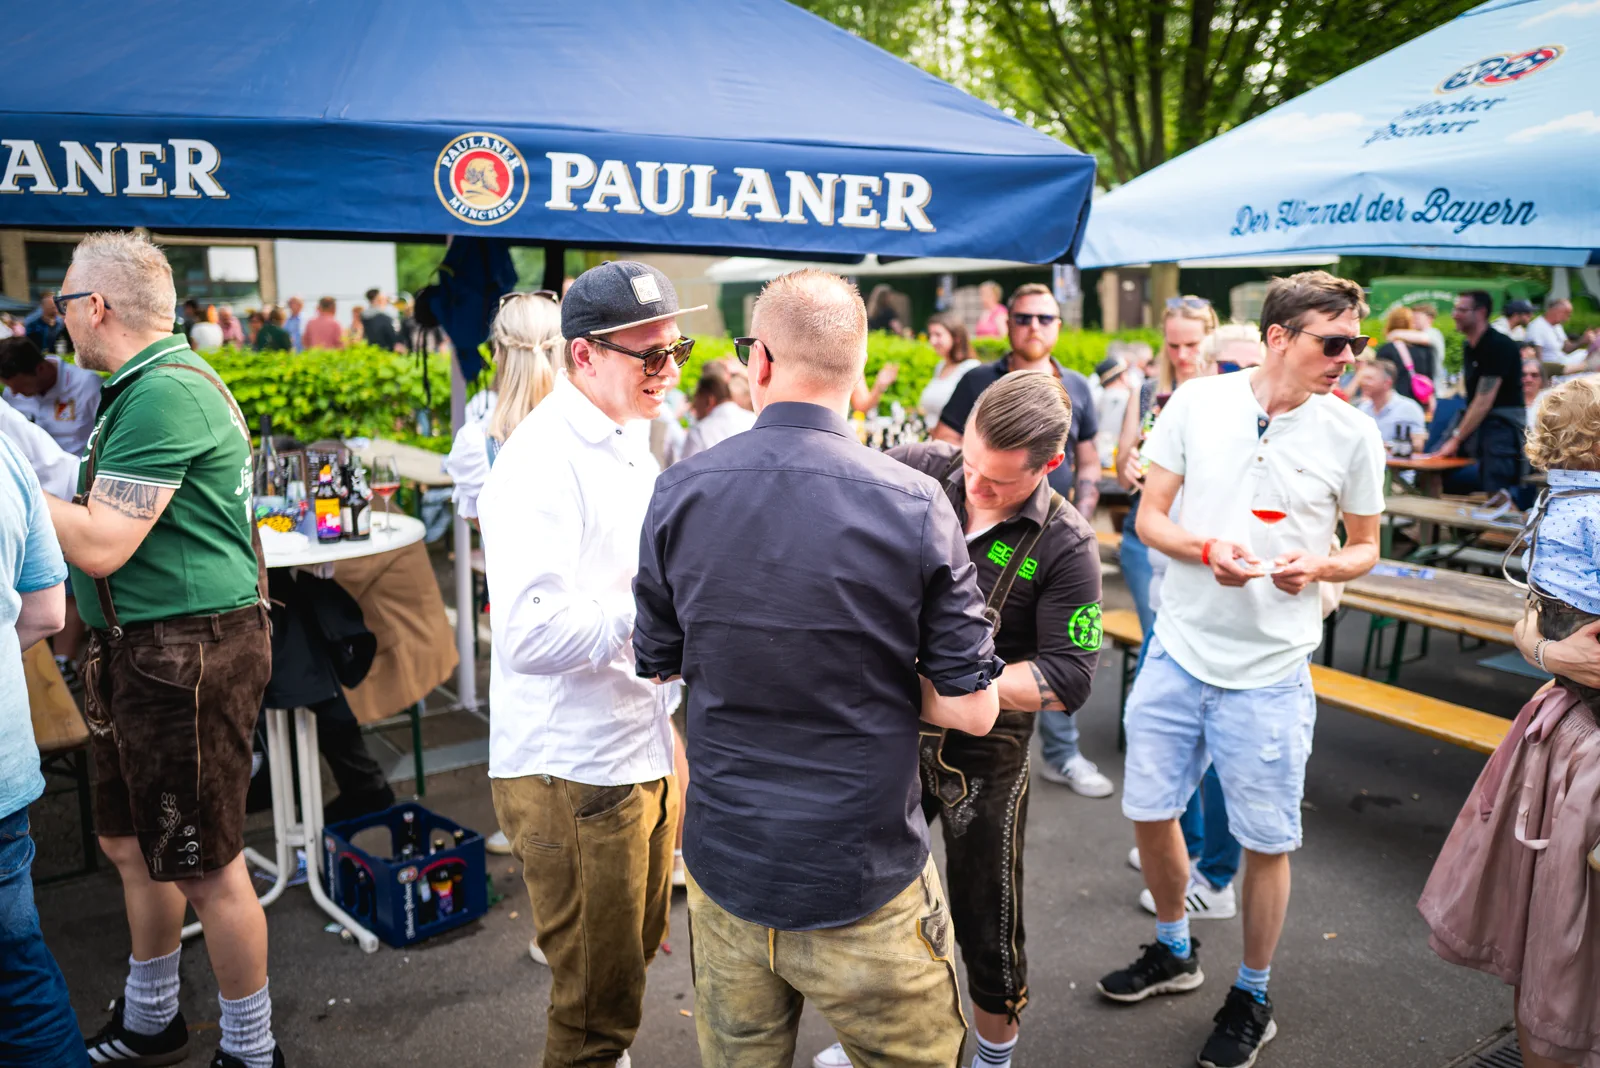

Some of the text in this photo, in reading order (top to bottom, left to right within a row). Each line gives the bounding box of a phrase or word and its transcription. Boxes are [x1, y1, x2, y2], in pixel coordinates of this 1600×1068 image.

[0, 138, 230, 199] ANER
[441, 136, 521, 169] PAULANER
[545, 151, 937, 232] PAULANER
[1230, 205, 1270, 236] Der
[1365, 192, 1407, 223] der
[1411, 187, 1538, 234] Bayern
